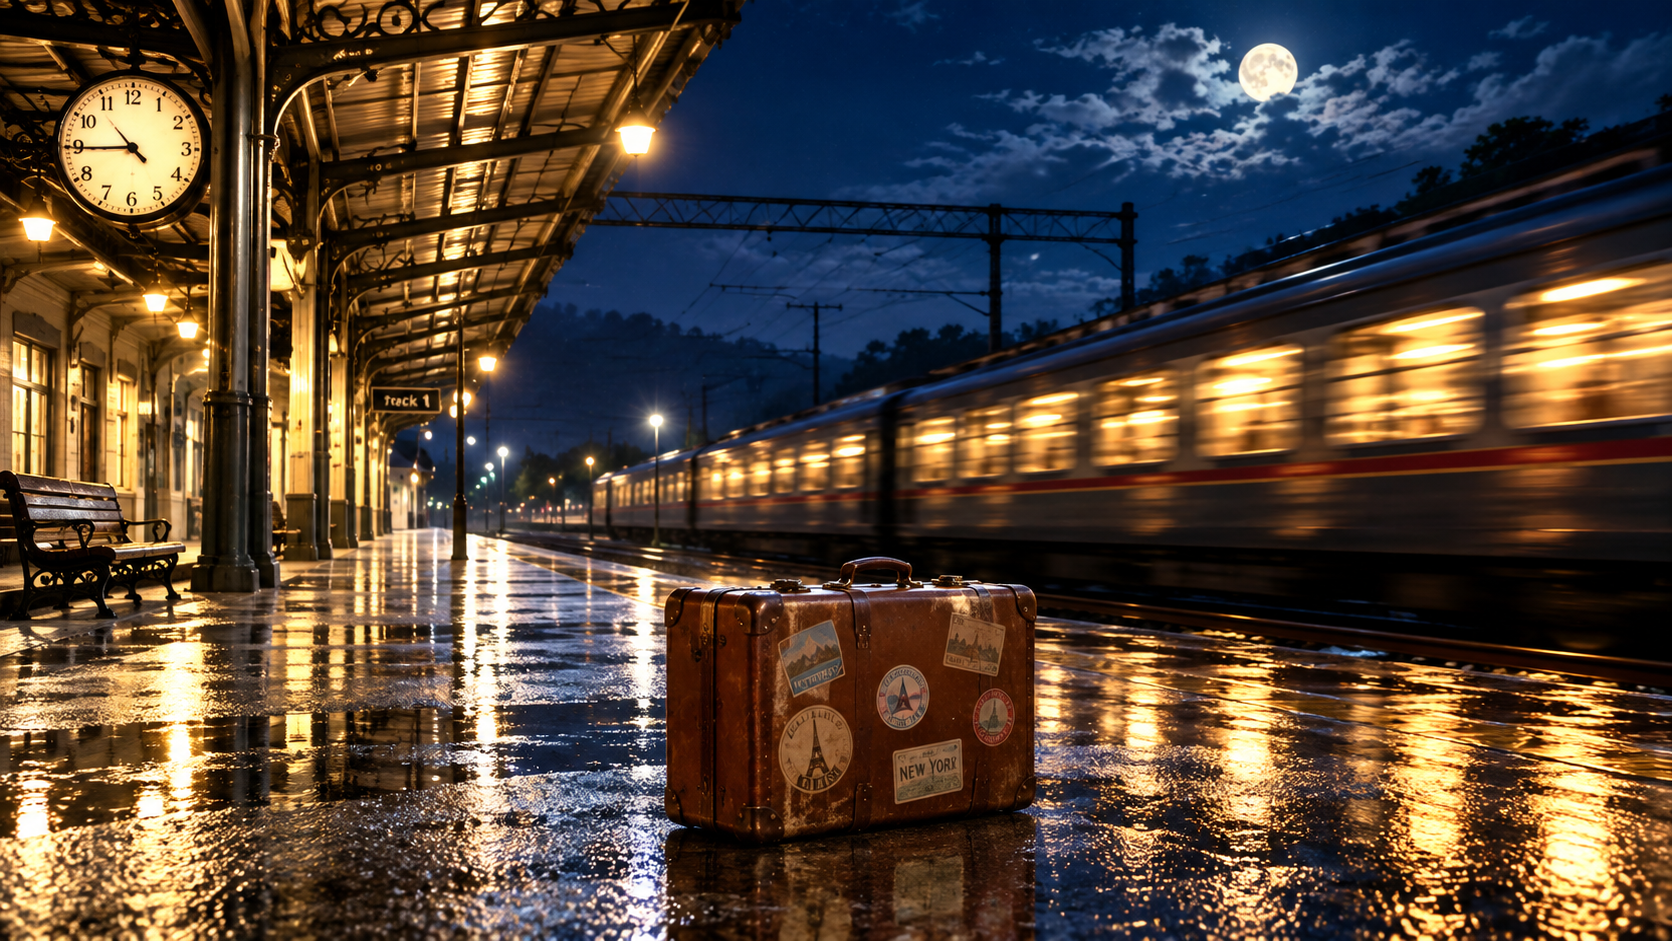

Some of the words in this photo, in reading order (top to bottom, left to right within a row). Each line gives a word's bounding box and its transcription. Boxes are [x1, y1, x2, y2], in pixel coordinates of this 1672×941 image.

[101, 96, 113, 111] 11
[125, 89, 141, 105] 12
[156, 97, 162, 112] 1
[80, 114, 96, 129] 10
[173, 115, 183, 130] 2
[73, 139, 84, 154] 9
[181, 142, 192, 156] 3
[81, 166, 92, 181] 8
[170, 167, 182, 182] 4
[101, 185, 112, 200] 7
[126, 191, 137, 207] 6
[152, 186, 163, 201] 5
[422, 393, 430, 408] 1
[899, 763, 926, 782] NEW
[928, 756, 957, 775] YORK
